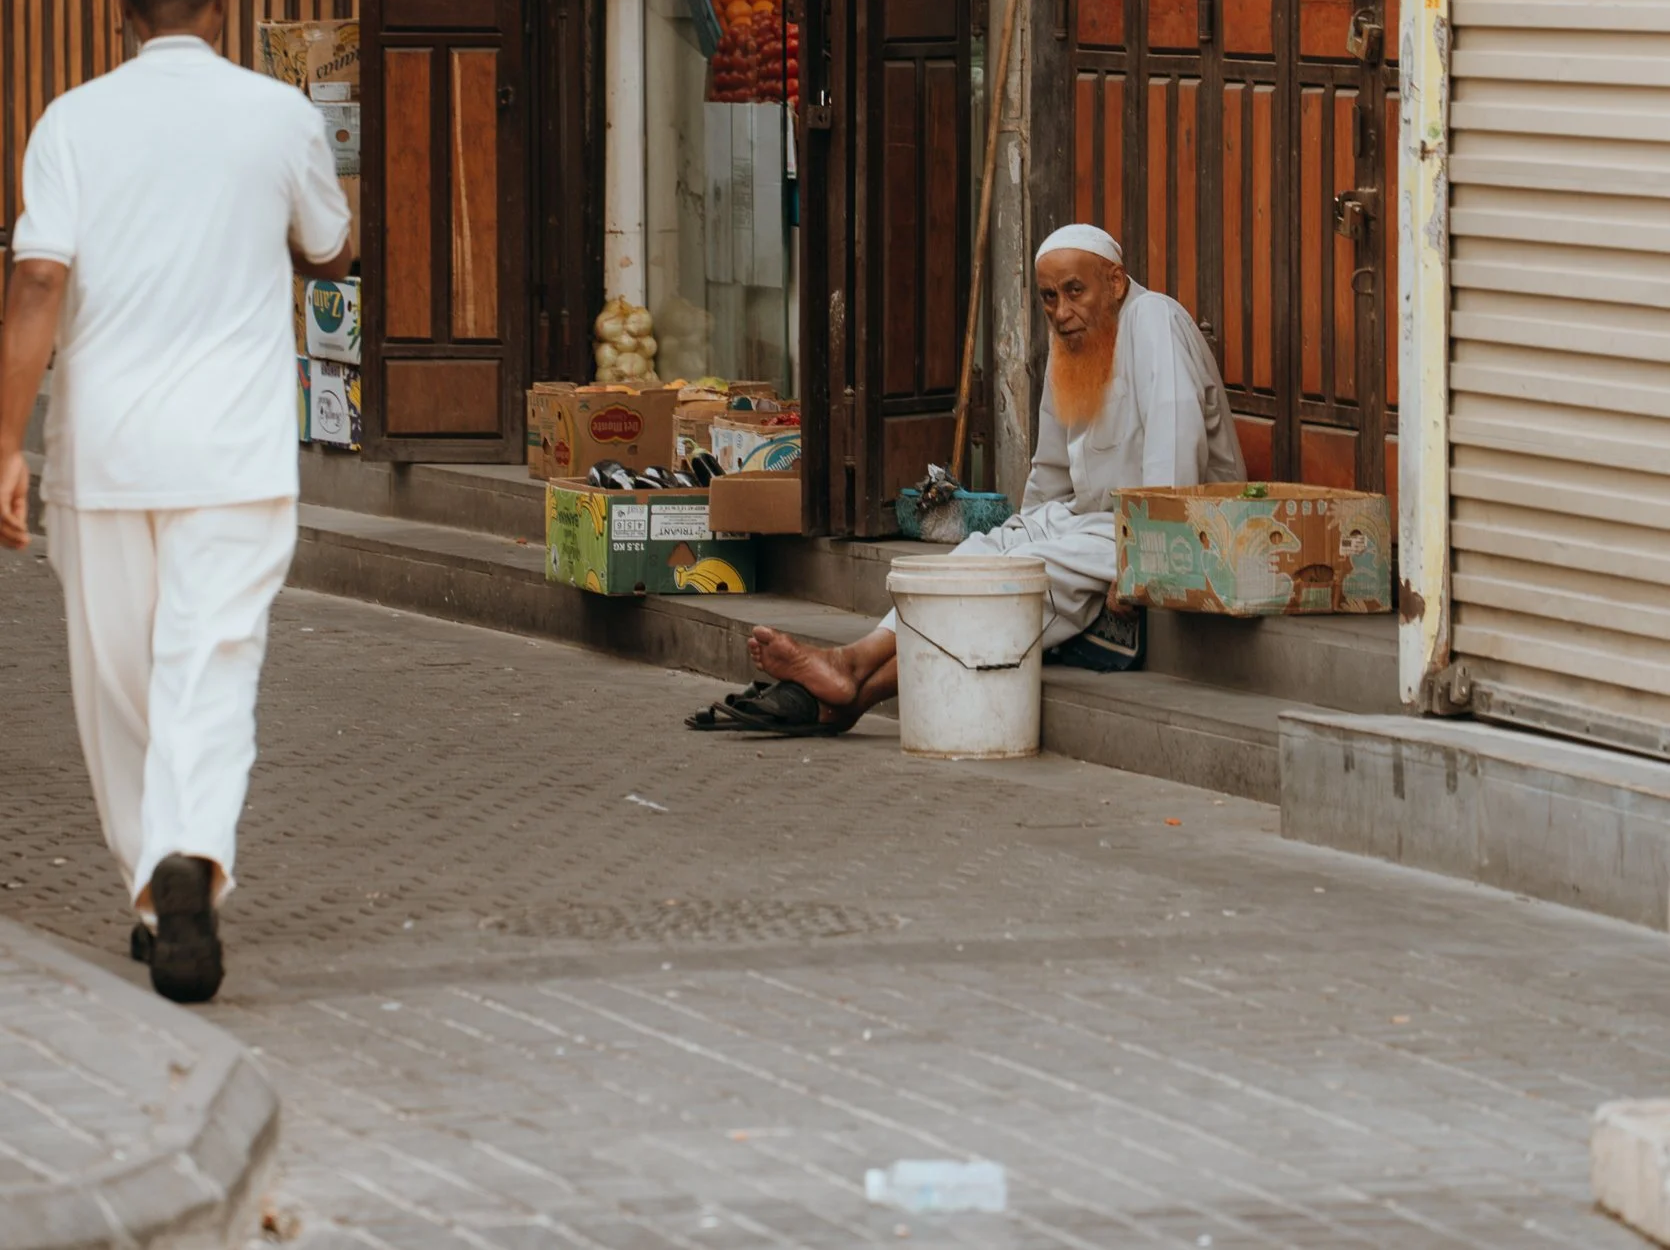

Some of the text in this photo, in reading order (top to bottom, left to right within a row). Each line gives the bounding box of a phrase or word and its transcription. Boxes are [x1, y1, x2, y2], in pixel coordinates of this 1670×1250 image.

[313, 288, 341, 318] Zain
[592, 421, 623, 433] Monte
[613, 542, 645, 552] 13.5 KG
